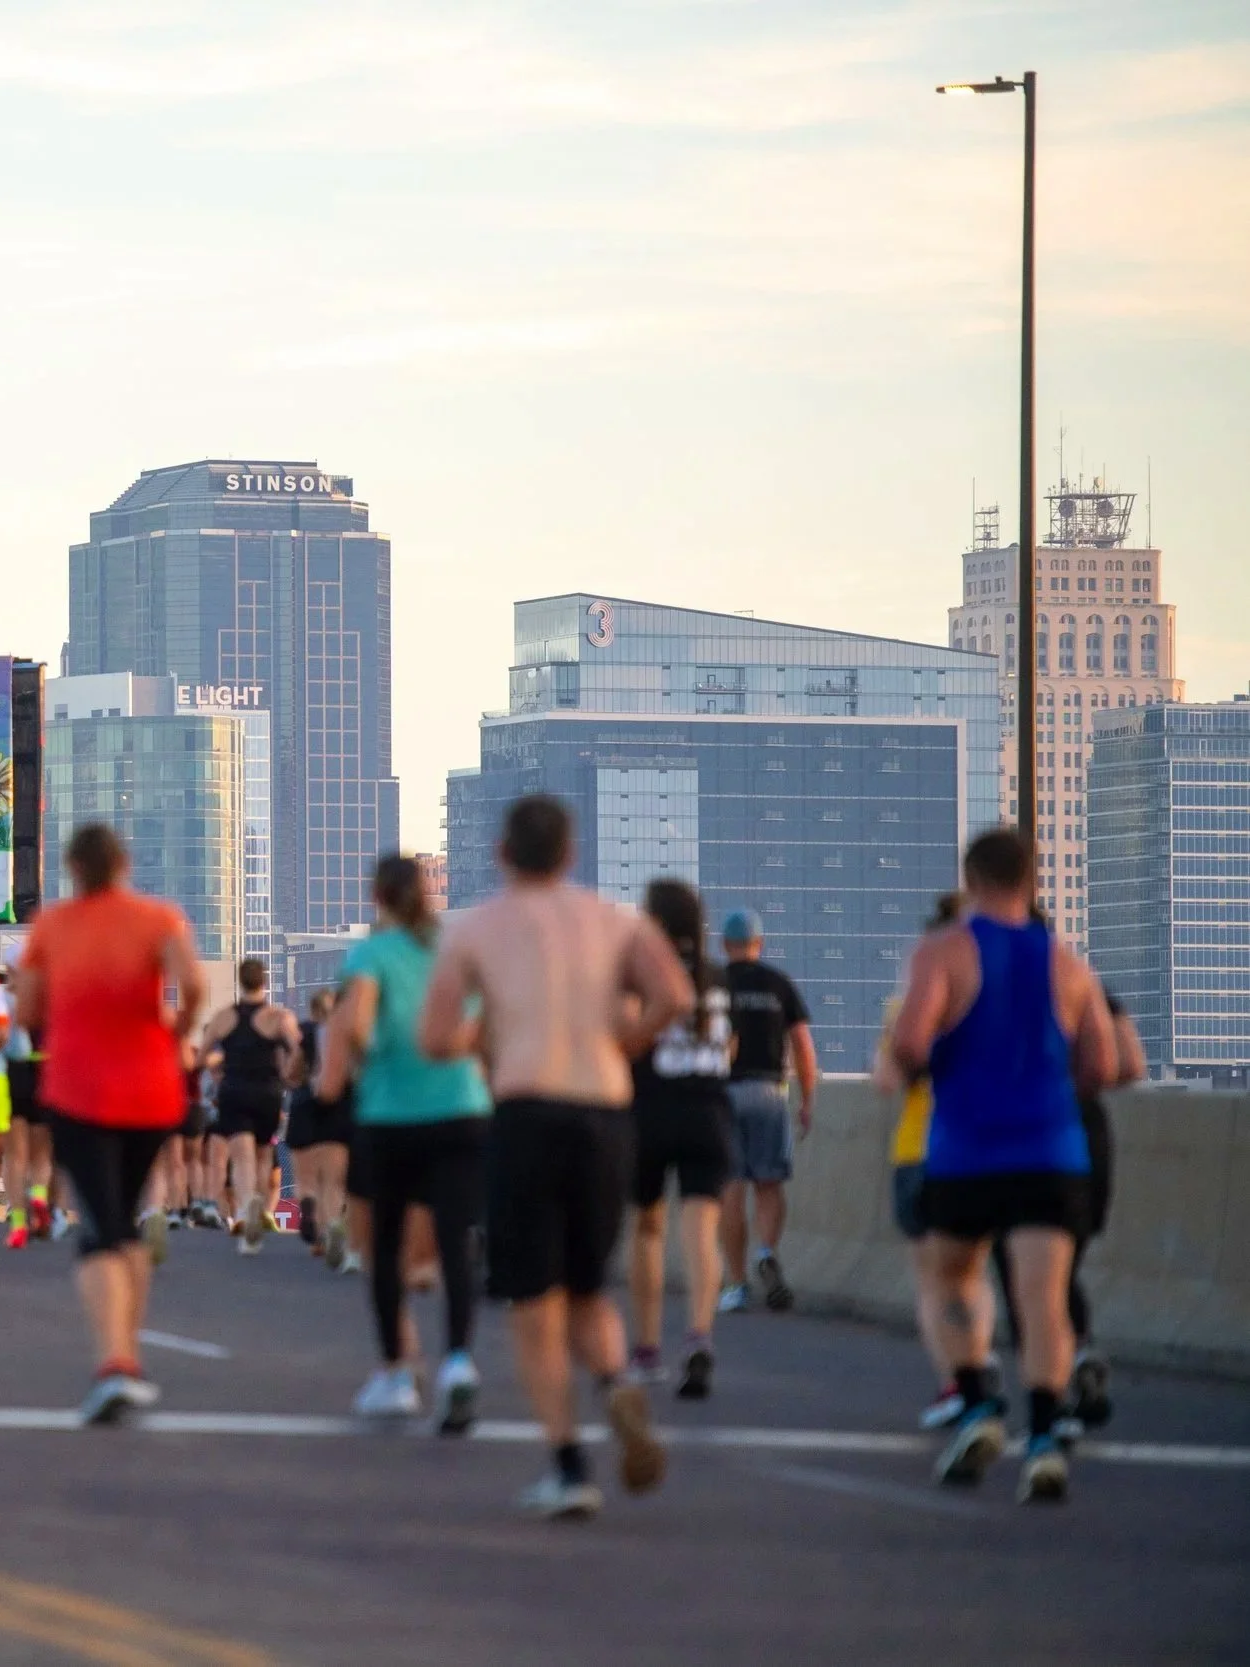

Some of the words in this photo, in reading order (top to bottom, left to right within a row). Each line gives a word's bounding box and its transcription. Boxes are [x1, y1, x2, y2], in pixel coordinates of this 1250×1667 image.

[226, 474, 331, 492] STINSON
[586, 600, 614, 648] 3
[195, 685, 263, 705] LIGHT
